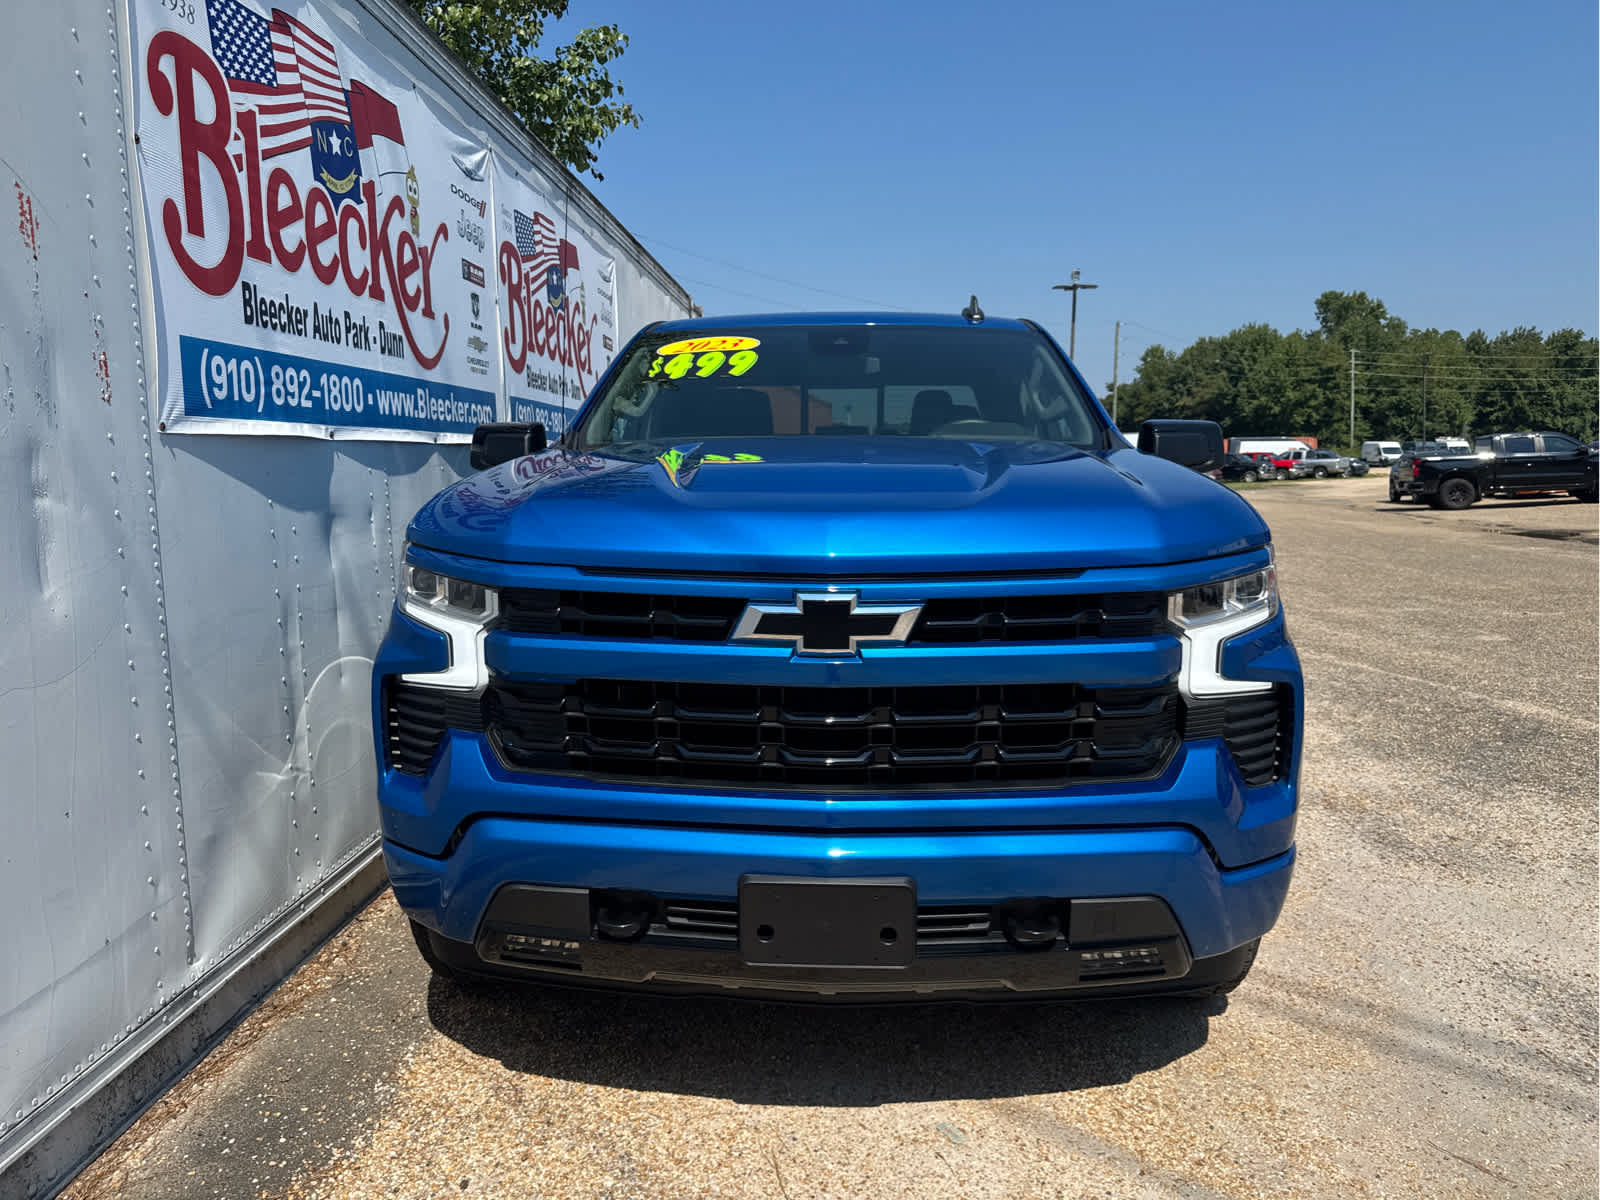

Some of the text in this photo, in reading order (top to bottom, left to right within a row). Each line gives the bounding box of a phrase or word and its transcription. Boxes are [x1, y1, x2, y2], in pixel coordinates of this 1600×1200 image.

[316, 127, 354, 158] N C
[147, 30, 449, 371] Bleecker
[450, 183, 481, 210] DODGE
[242, 280, 404, 359] Bleecker Auto Park Dunn
[499, 240, 597, 399] Bleecker
[201, 349, 493, 424] (910) 892-1800 www.Bleecker.com
[648, 350, 759, 380] $499
